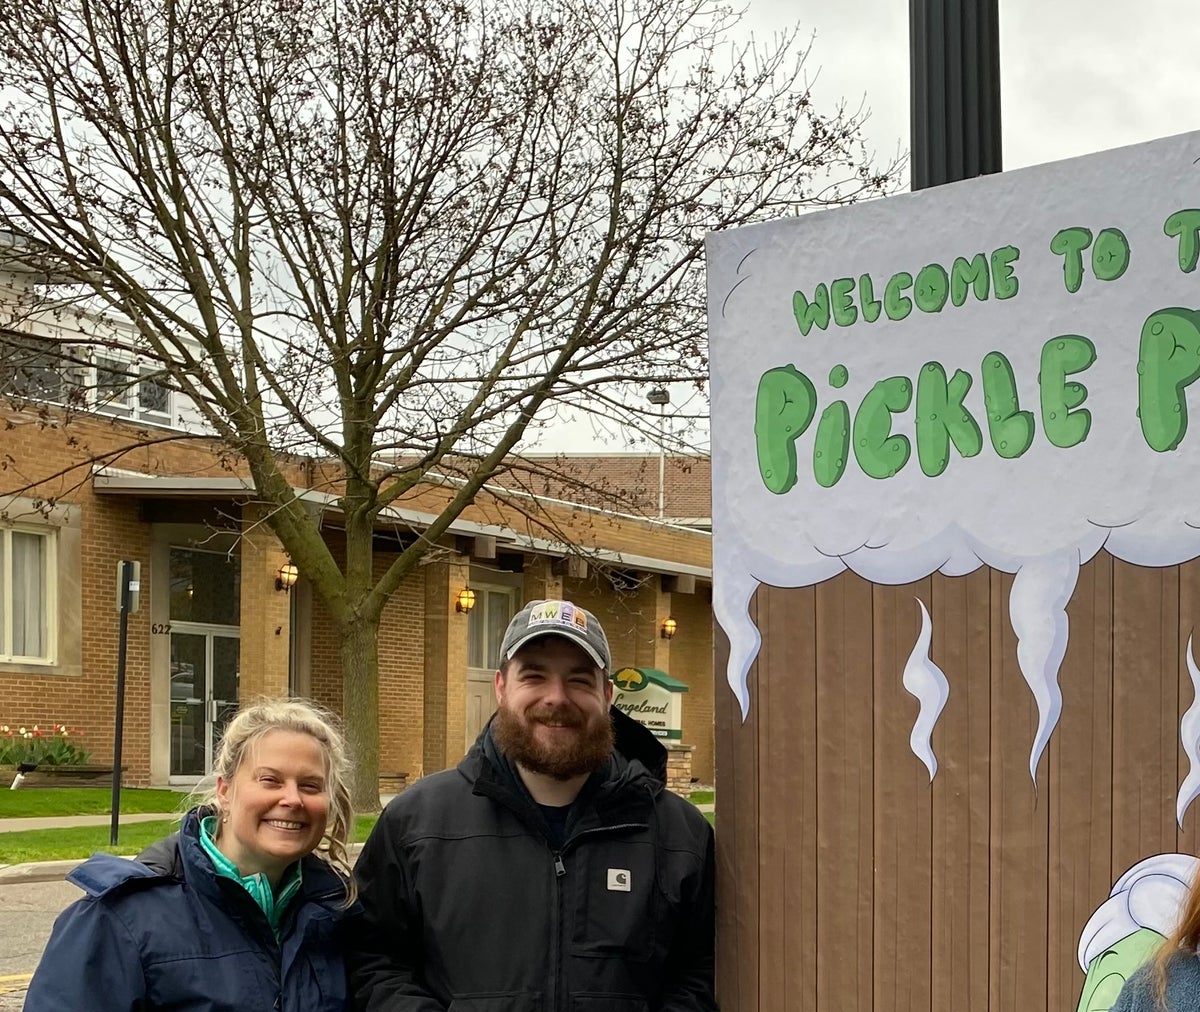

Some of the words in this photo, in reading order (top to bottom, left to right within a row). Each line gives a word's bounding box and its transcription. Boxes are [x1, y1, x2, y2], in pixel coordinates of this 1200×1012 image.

[792, 245, 1020, 336] WELCOME
[1050, 226, 1131, 294] TO
[151, 623, 172, 635] 622
